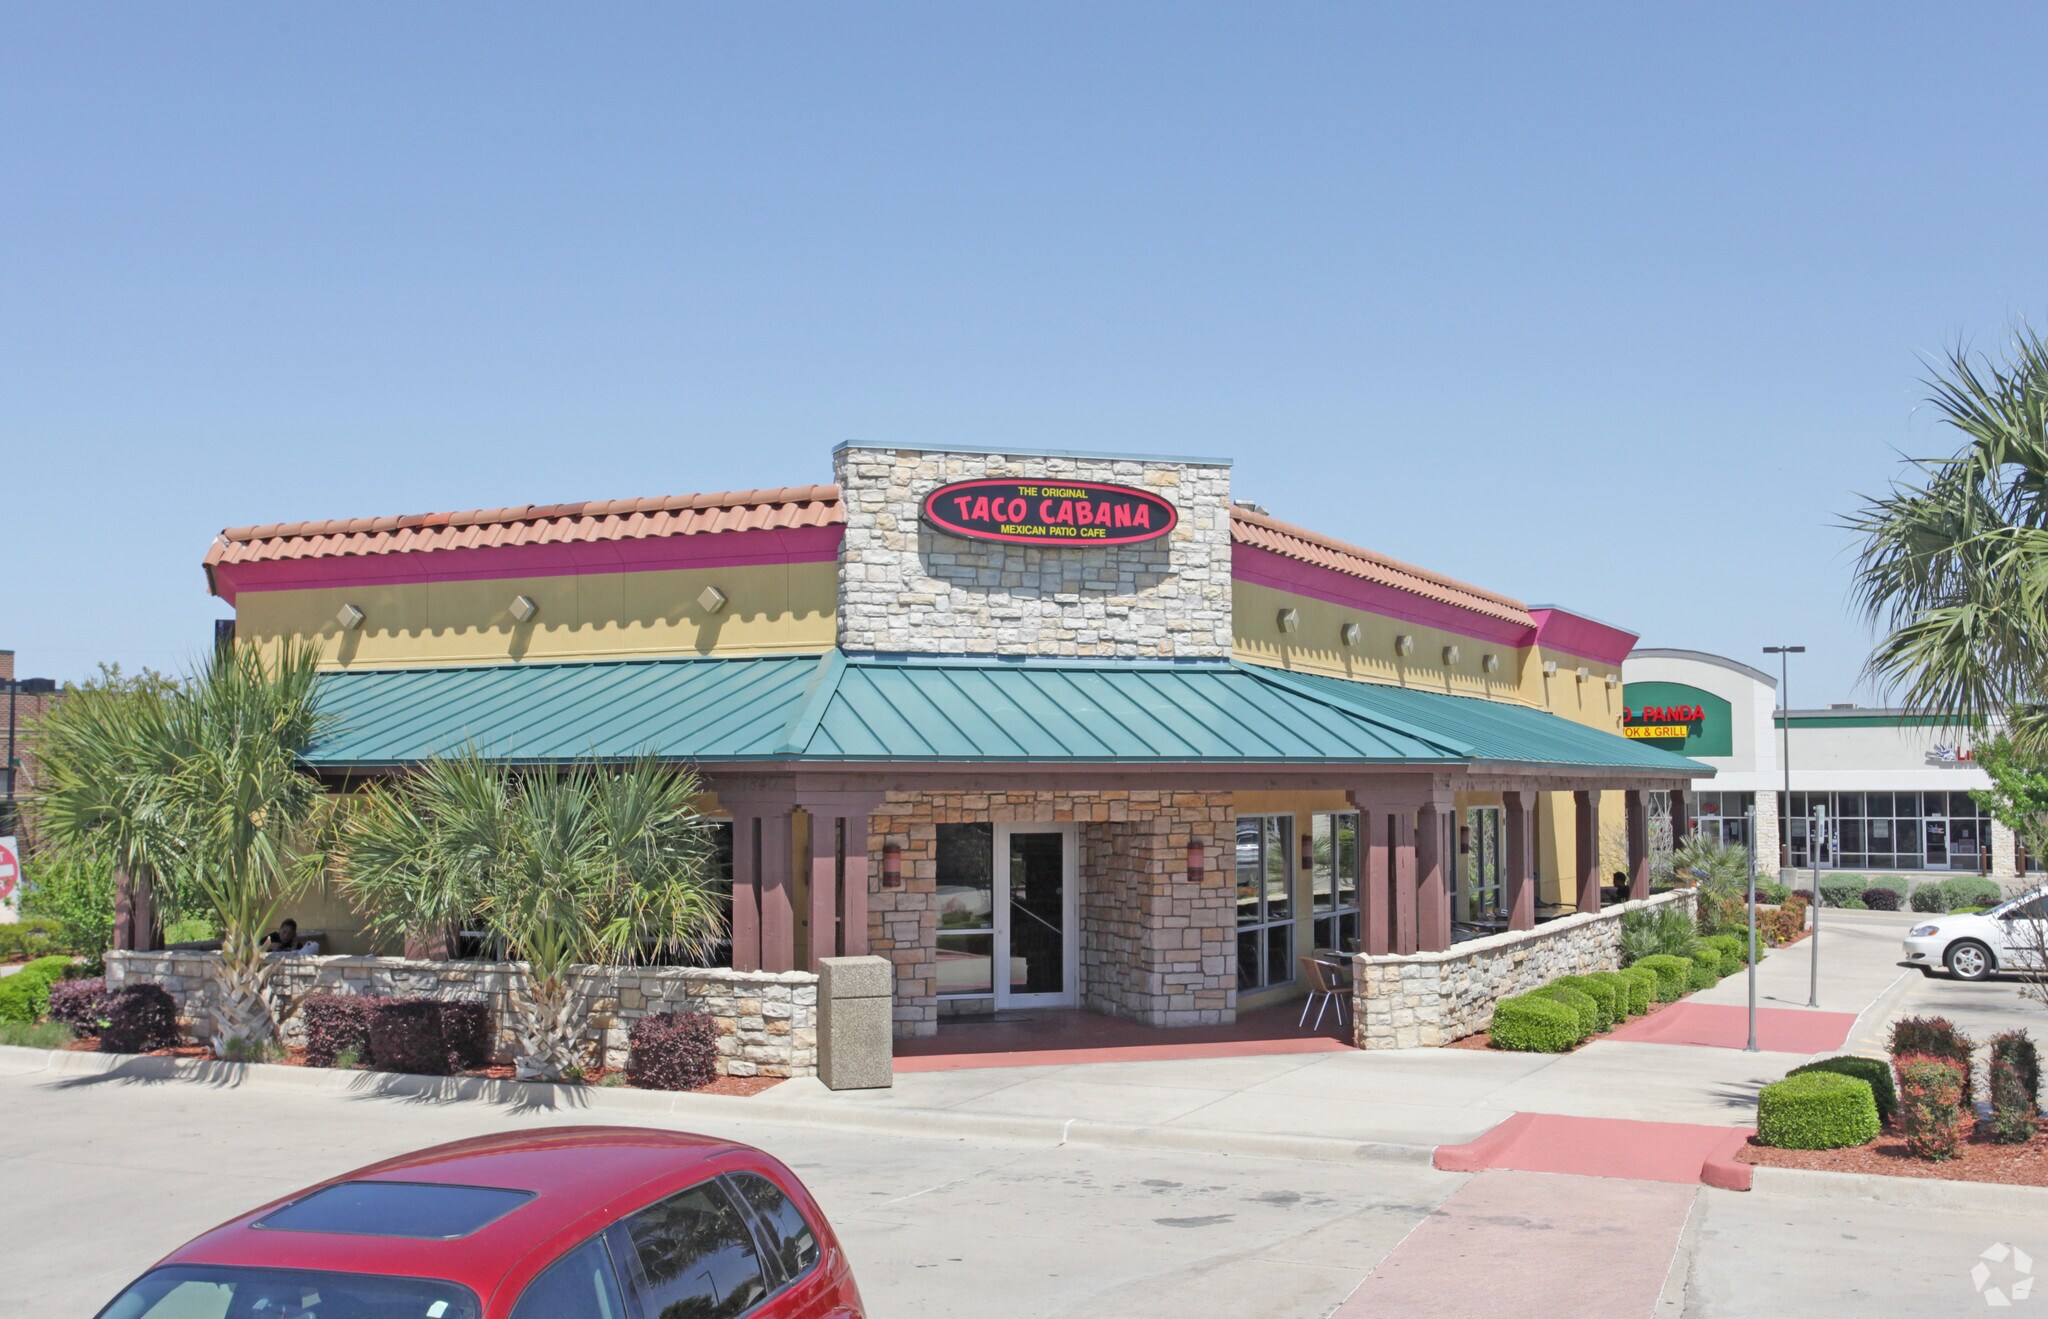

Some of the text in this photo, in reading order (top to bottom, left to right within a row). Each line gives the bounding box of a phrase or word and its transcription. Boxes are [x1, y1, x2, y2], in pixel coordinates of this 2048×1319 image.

[1018, 486, 1088, 499] THE ORIGINAL
[954, 496, 1150, 529] TACO CABANA
[1000, 524, 1106, 538] MEXICAN PATIO CAFE
[1643, 704, 1706, 722] PANDA
[1623, 727, 1686, 737] OK & GRILL
